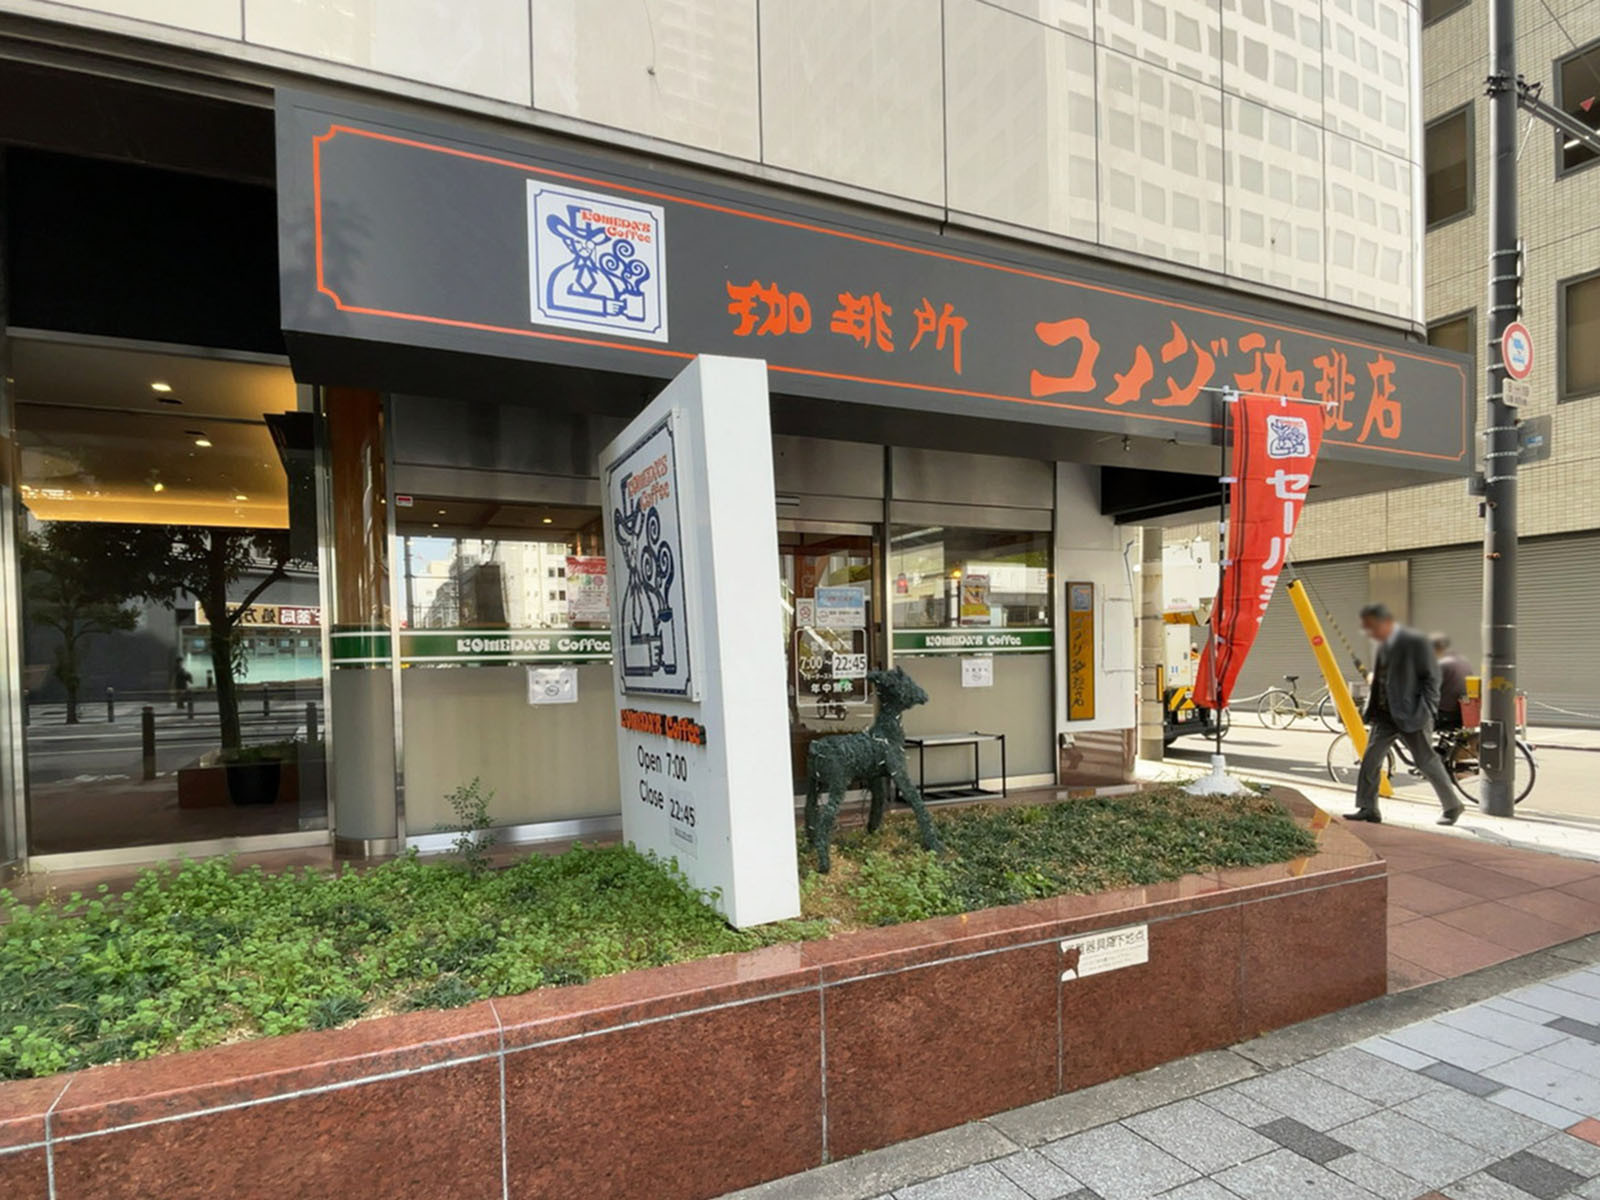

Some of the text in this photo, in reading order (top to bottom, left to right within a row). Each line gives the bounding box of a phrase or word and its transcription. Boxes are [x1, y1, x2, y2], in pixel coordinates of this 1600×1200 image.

[581, 210, 651, 233] KOMEDA'S
[605, 226, 651, 243] Coffee
[727, 279, 1402, 443] 珈琲所 コメダ珈琲店
[457, 638, 611, 652] KOMEDA'S Coffee
[987, 635, 1021, 645] Coffee
[835, 656, 867, 671] 22:45
[637, 745, 687, 781] Open 7:00
[639, 780, 696, 827] Close 22:45
